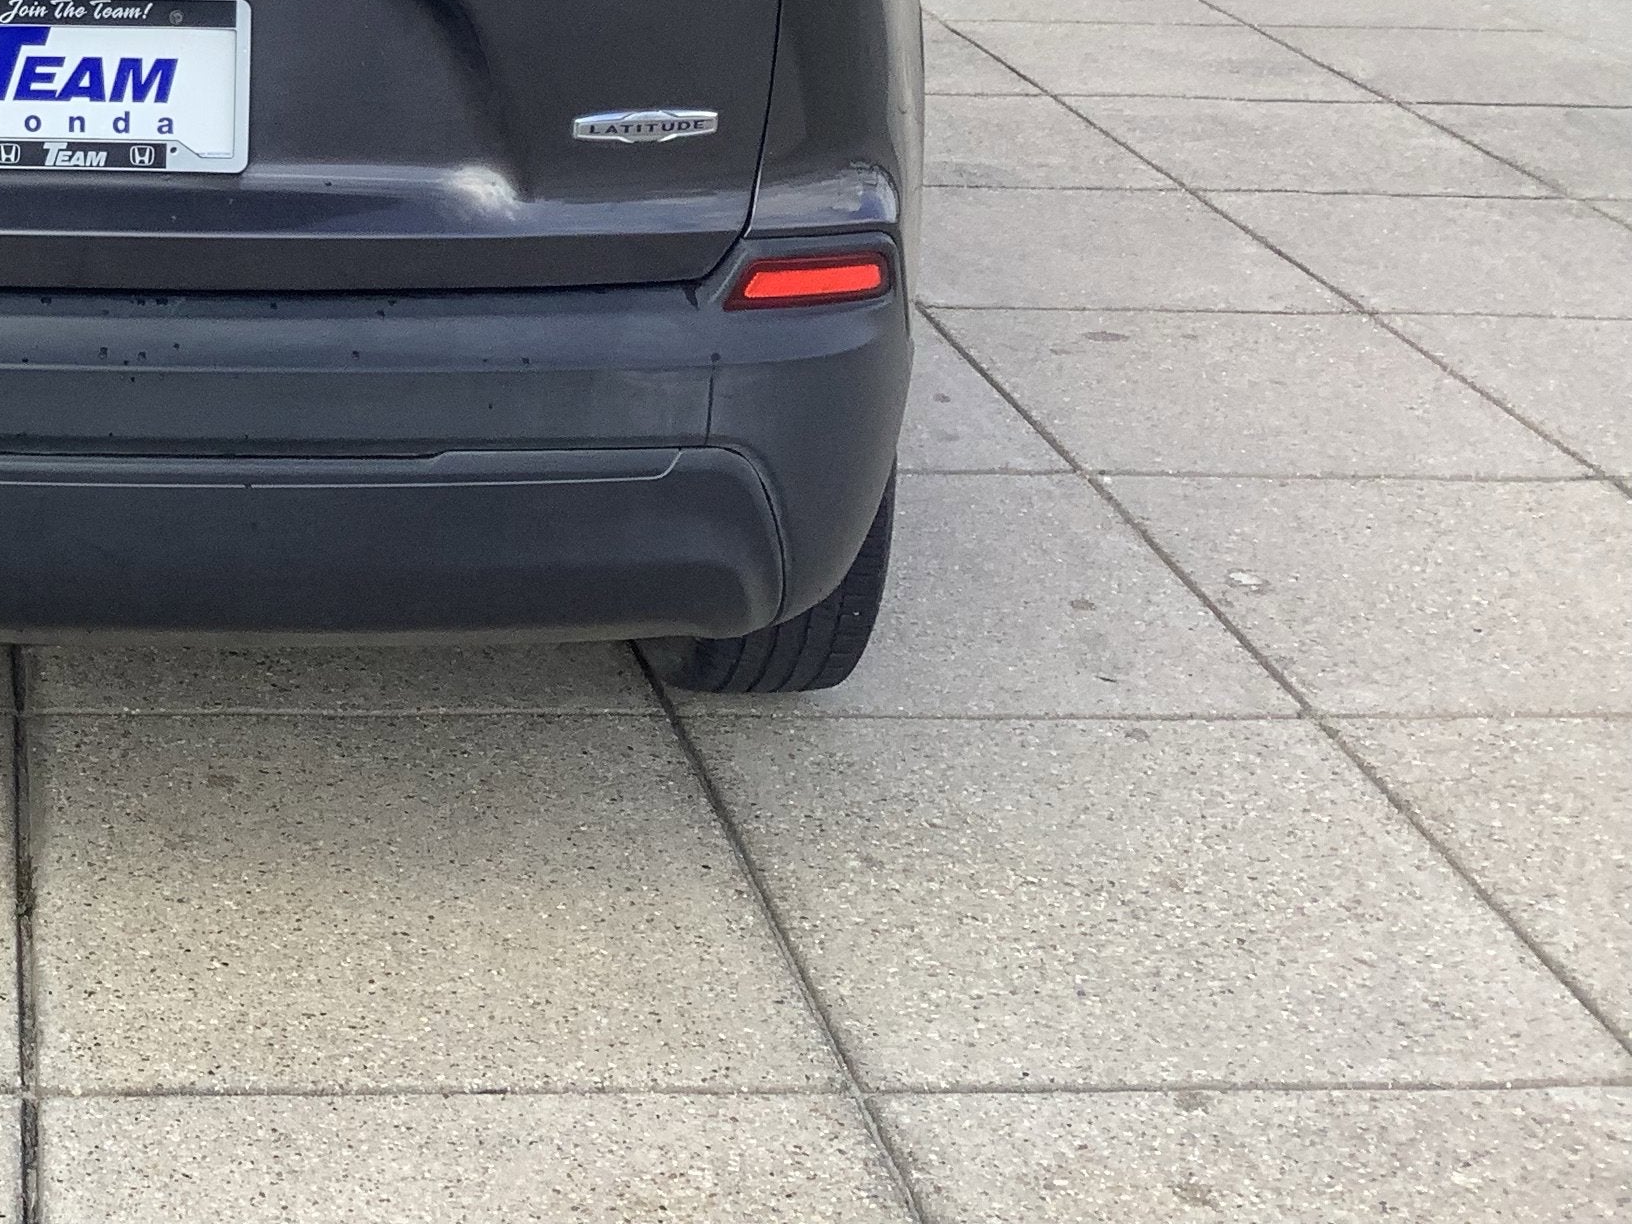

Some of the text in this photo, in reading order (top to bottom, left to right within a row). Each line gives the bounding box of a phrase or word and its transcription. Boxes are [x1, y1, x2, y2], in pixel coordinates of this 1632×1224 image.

[50, 0, 87, 19] The
[89, 0, 153, 19] Team!
[588, 119, 706, 134] LATITUDE
[43, 142, 107, 167] TEAM
